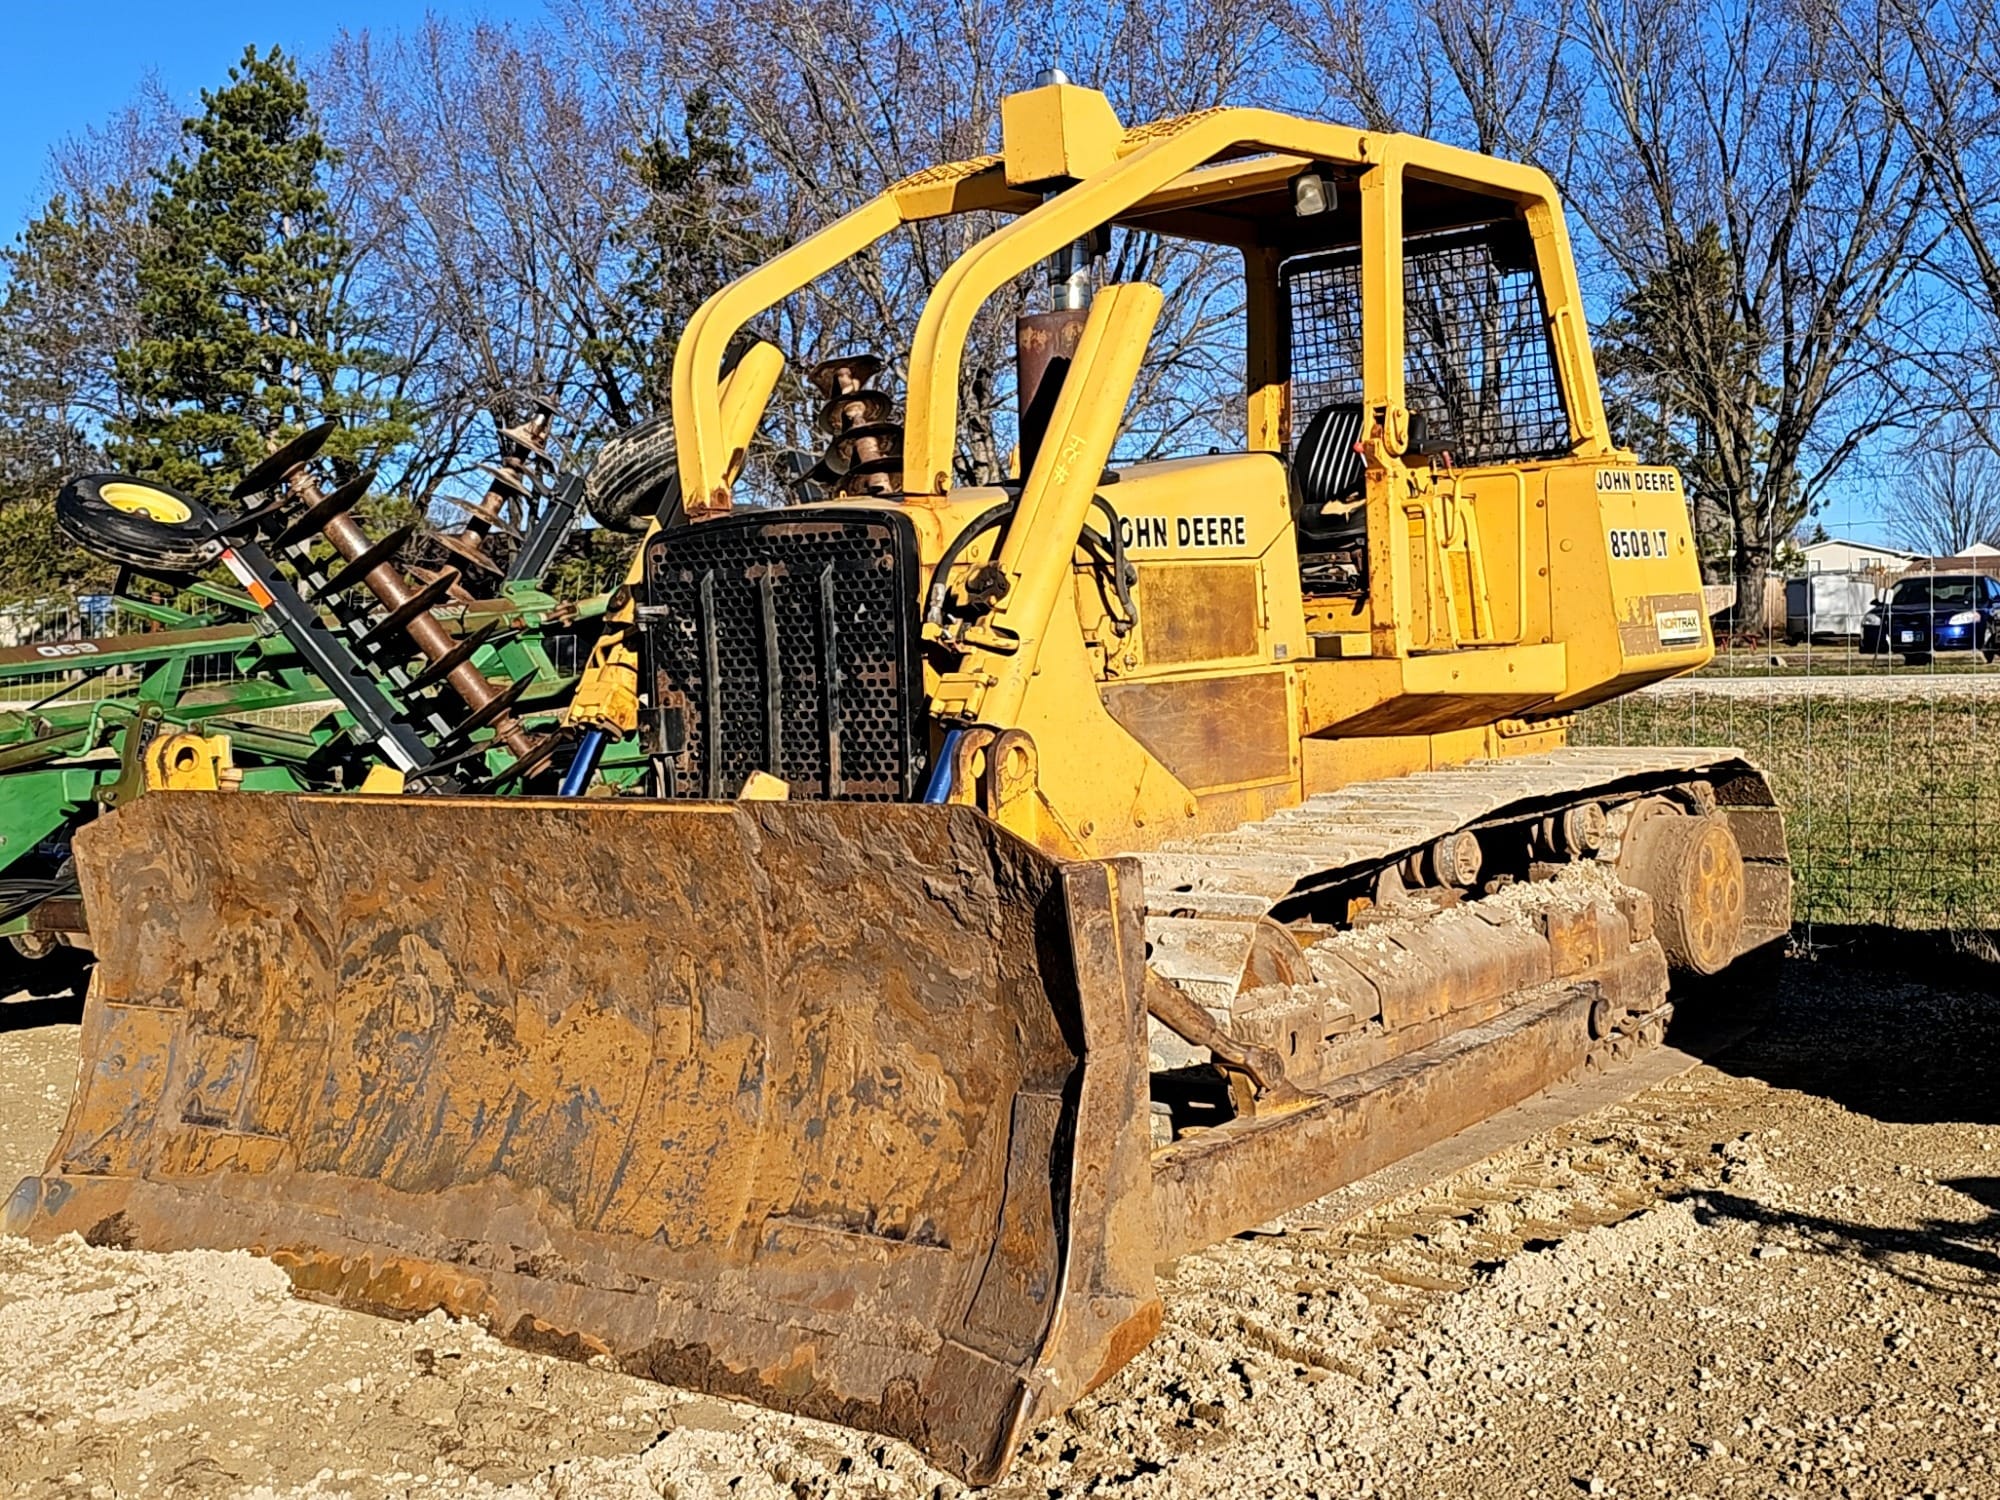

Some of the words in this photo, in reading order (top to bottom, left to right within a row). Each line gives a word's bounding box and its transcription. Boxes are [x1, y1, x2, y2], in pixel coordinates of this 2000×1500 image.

[1596, 471, 1631, 490] JOHN
[1635, 472, 1675, 491] DEERE
[1104, 516, 1167, 548] OHN
[1177, 517, 1245, 547] DEERE
[1610, 530, 1650, 558] 850B
[1660, 616, 1697, 630] NORTRAX
